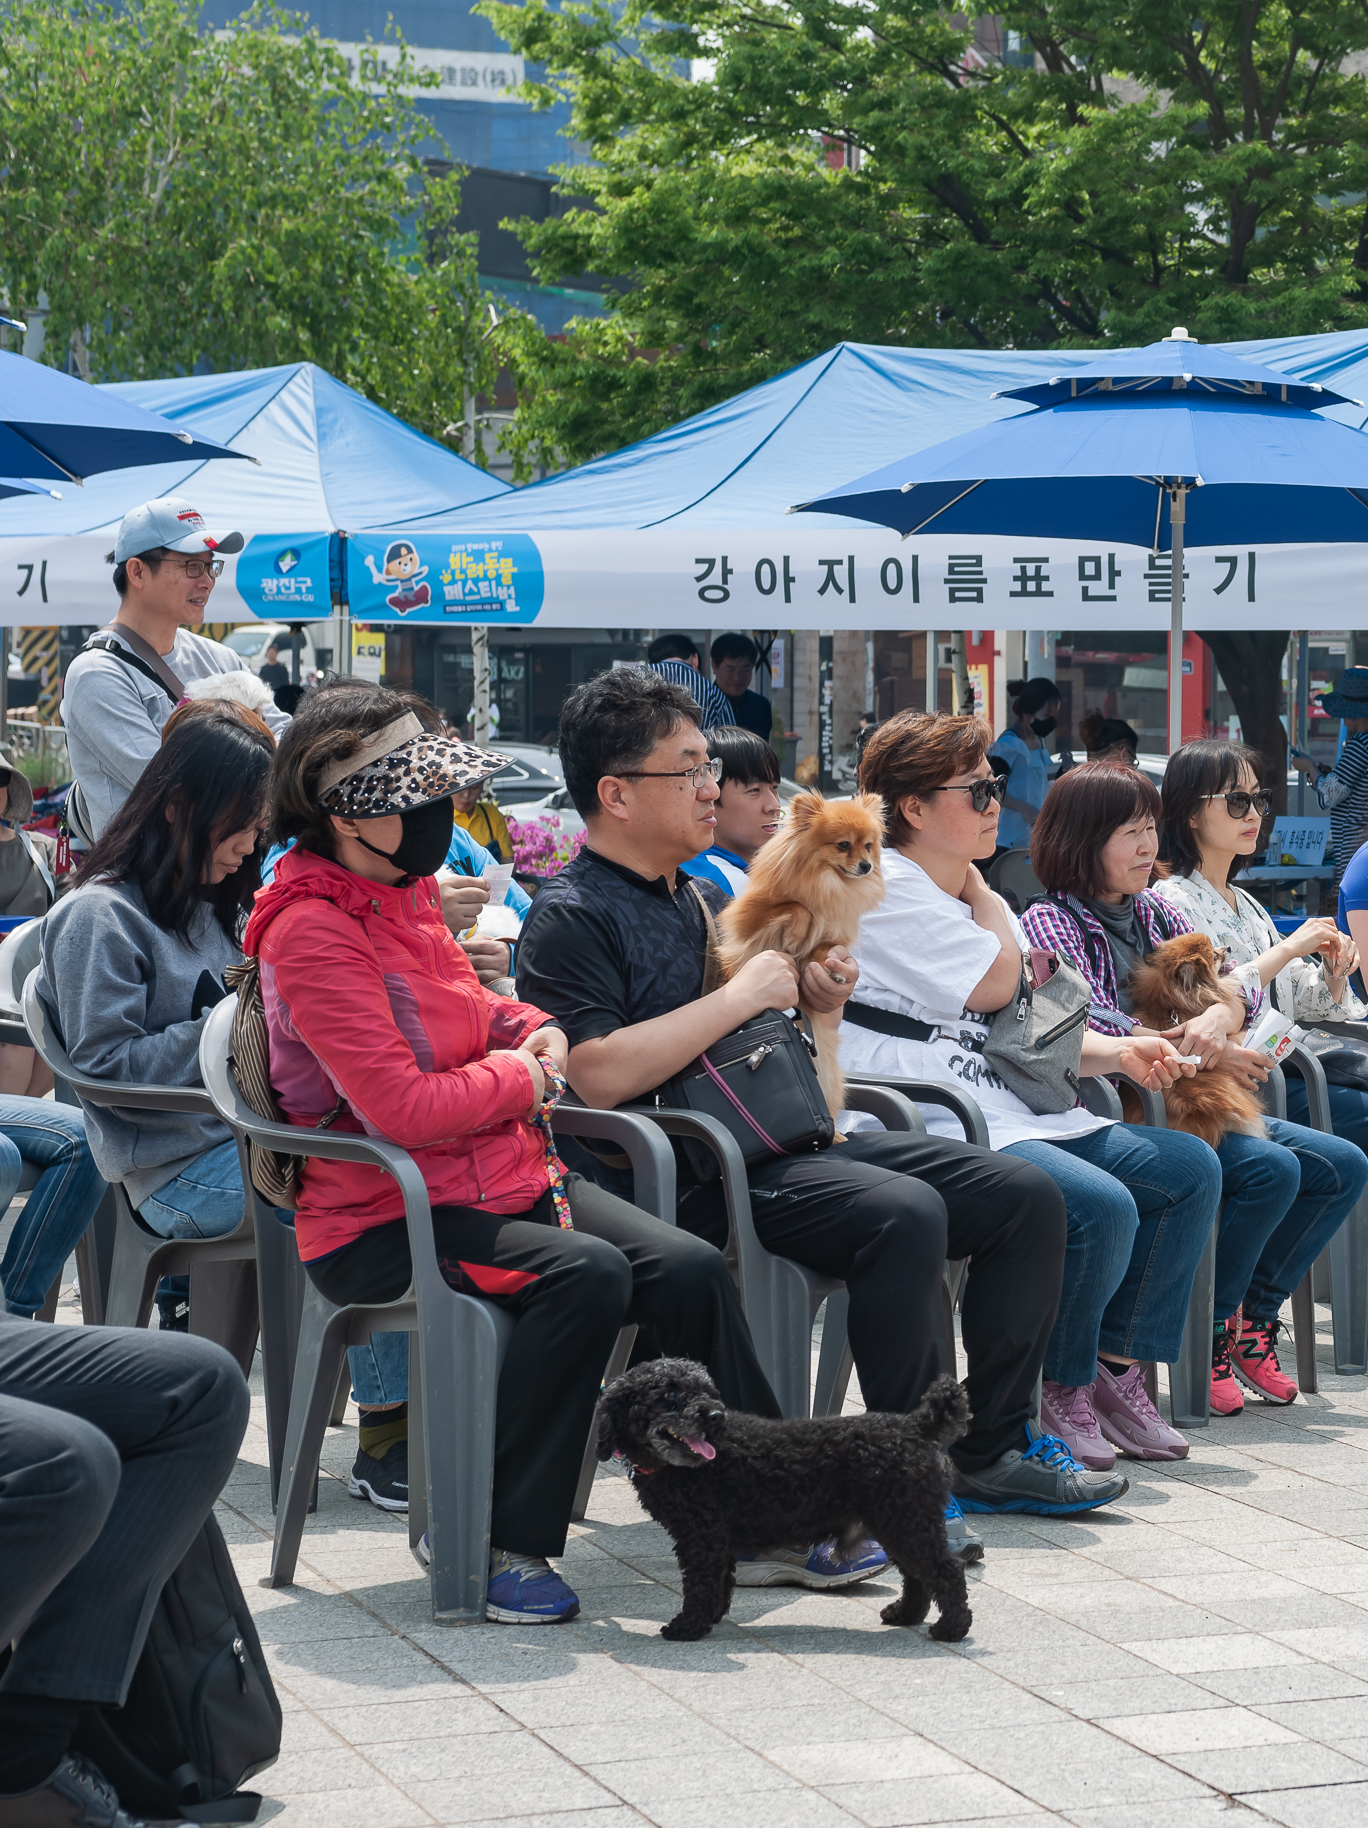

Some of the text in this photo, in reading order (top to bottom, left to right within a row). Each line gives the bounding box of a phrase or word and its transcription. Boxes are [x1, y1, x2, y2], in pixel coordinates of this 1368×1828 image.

[16, 559, 48, 603] 기
[449, 552, 518, 585] 반려동물
[260, 577, 313, 594] 광진구
[443, 579, 520, 612] 페스티벌
[1289, 830, 1306, 849] 휴식중
[1306, 830, 1324, 849] 입니다
